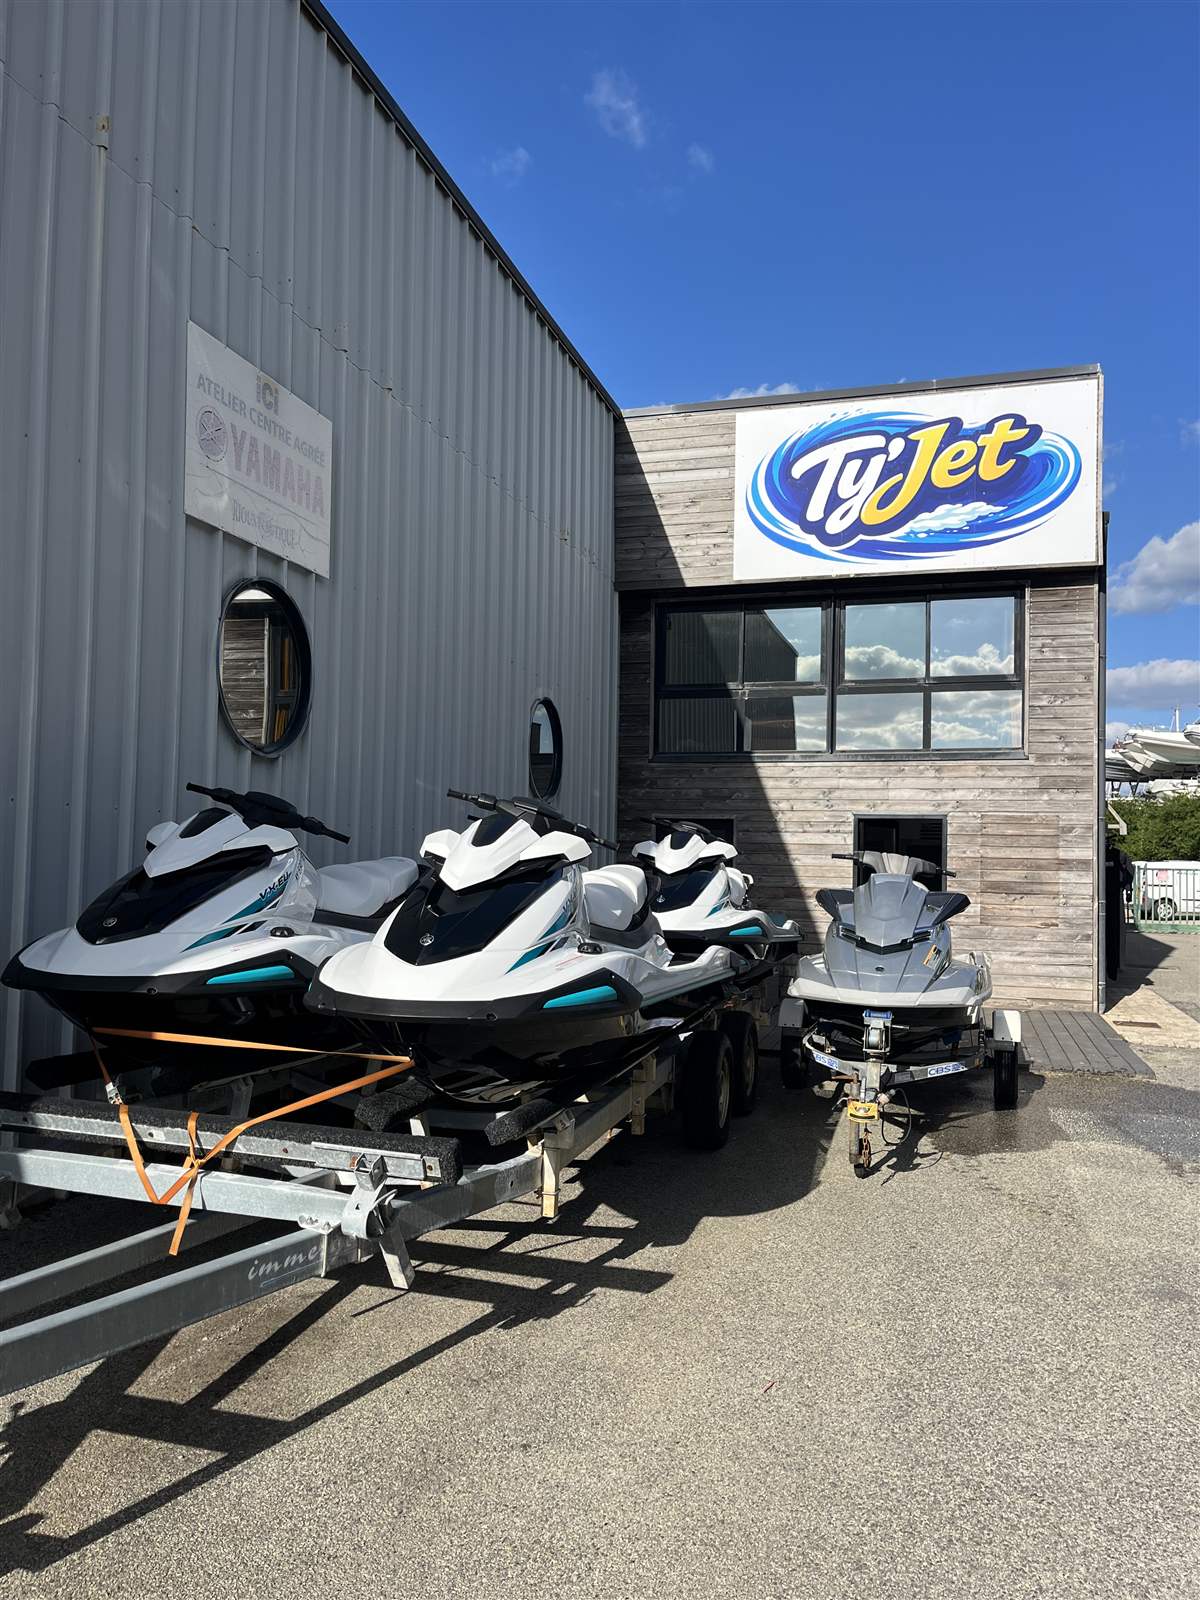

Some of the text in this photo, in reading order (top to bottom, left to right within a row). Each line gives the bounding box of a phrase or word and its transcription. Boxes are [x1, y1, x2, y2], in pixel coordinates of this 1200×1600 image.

[197, 372, 248, 421] ATELIER
[249, 405, 291, 447] CENTRE
[229, 422, 325, 518] YAMAHA
